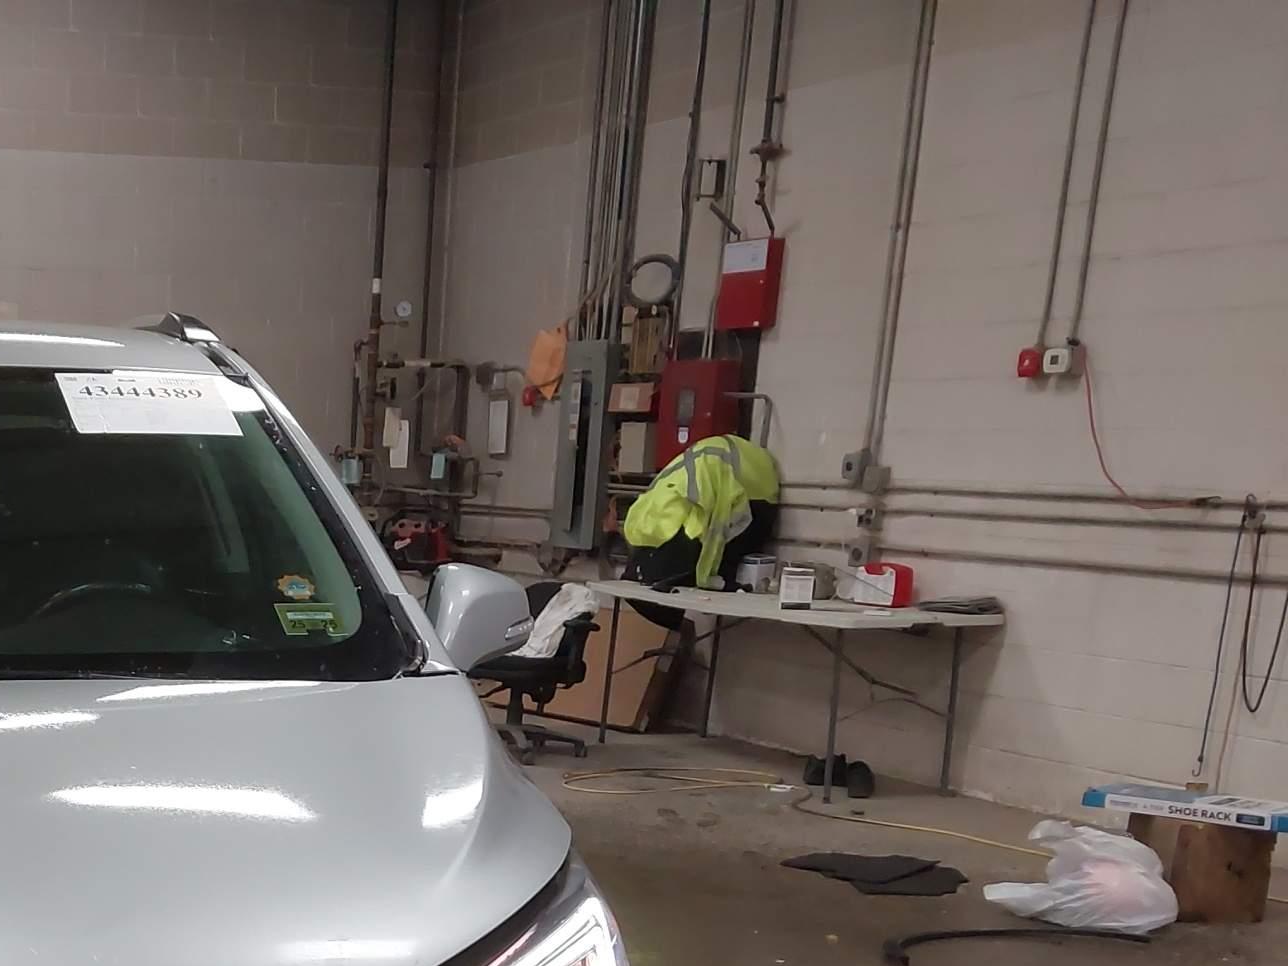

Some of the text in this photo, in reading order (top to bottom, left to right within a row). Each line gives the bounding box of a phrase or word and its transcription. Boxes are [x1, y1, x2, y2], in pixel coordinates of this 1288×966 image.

[78, 385, 203, 399] 43444389
[1167, 805, 1199, 818] SHOE
[1200, 810, 1232, 822] RACK
